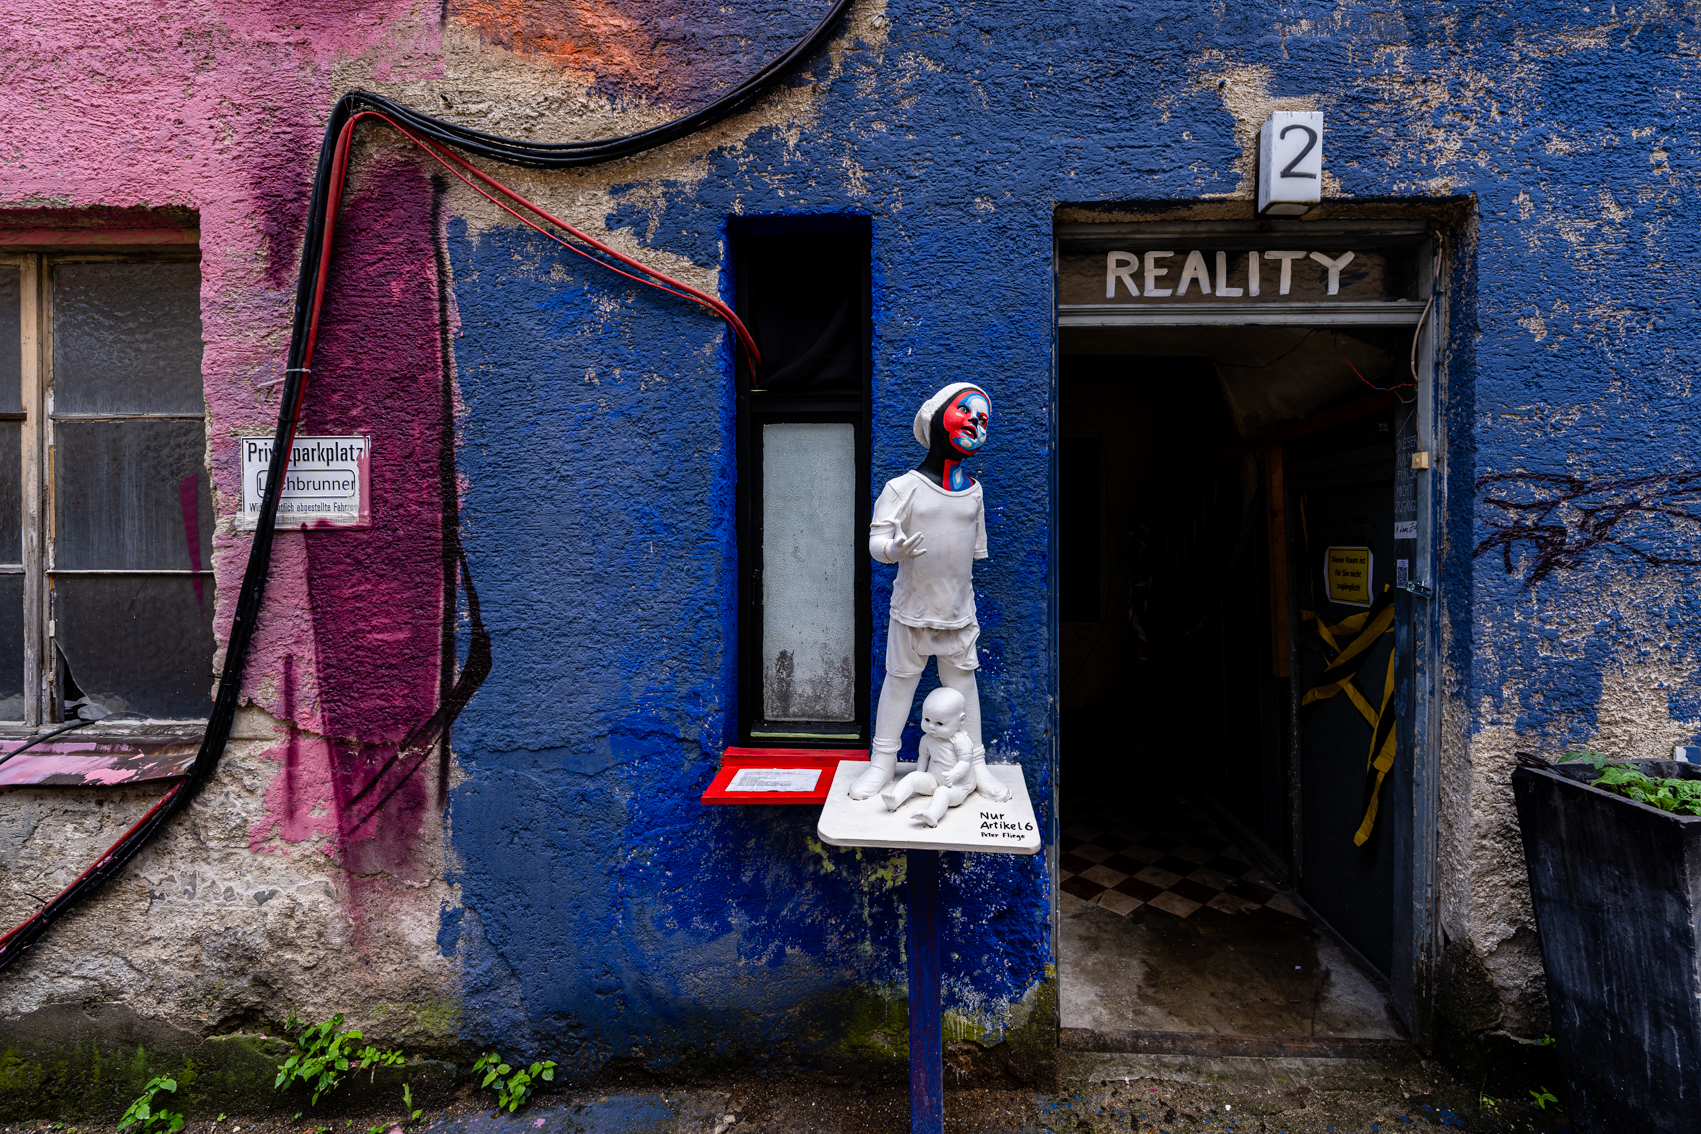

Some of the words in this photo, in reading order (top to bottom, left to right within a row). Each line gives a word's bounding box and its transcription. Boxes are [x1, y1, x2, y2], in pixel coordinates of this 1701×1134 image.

[1279, 123, 1318, 179] 2
[1105, 250, 1355, 299] REALITY
[297, 502, 331, 513] abgestellte
[1350, 569, 1361, 577] nicht
[980, 811, 1005, 820] Nur
